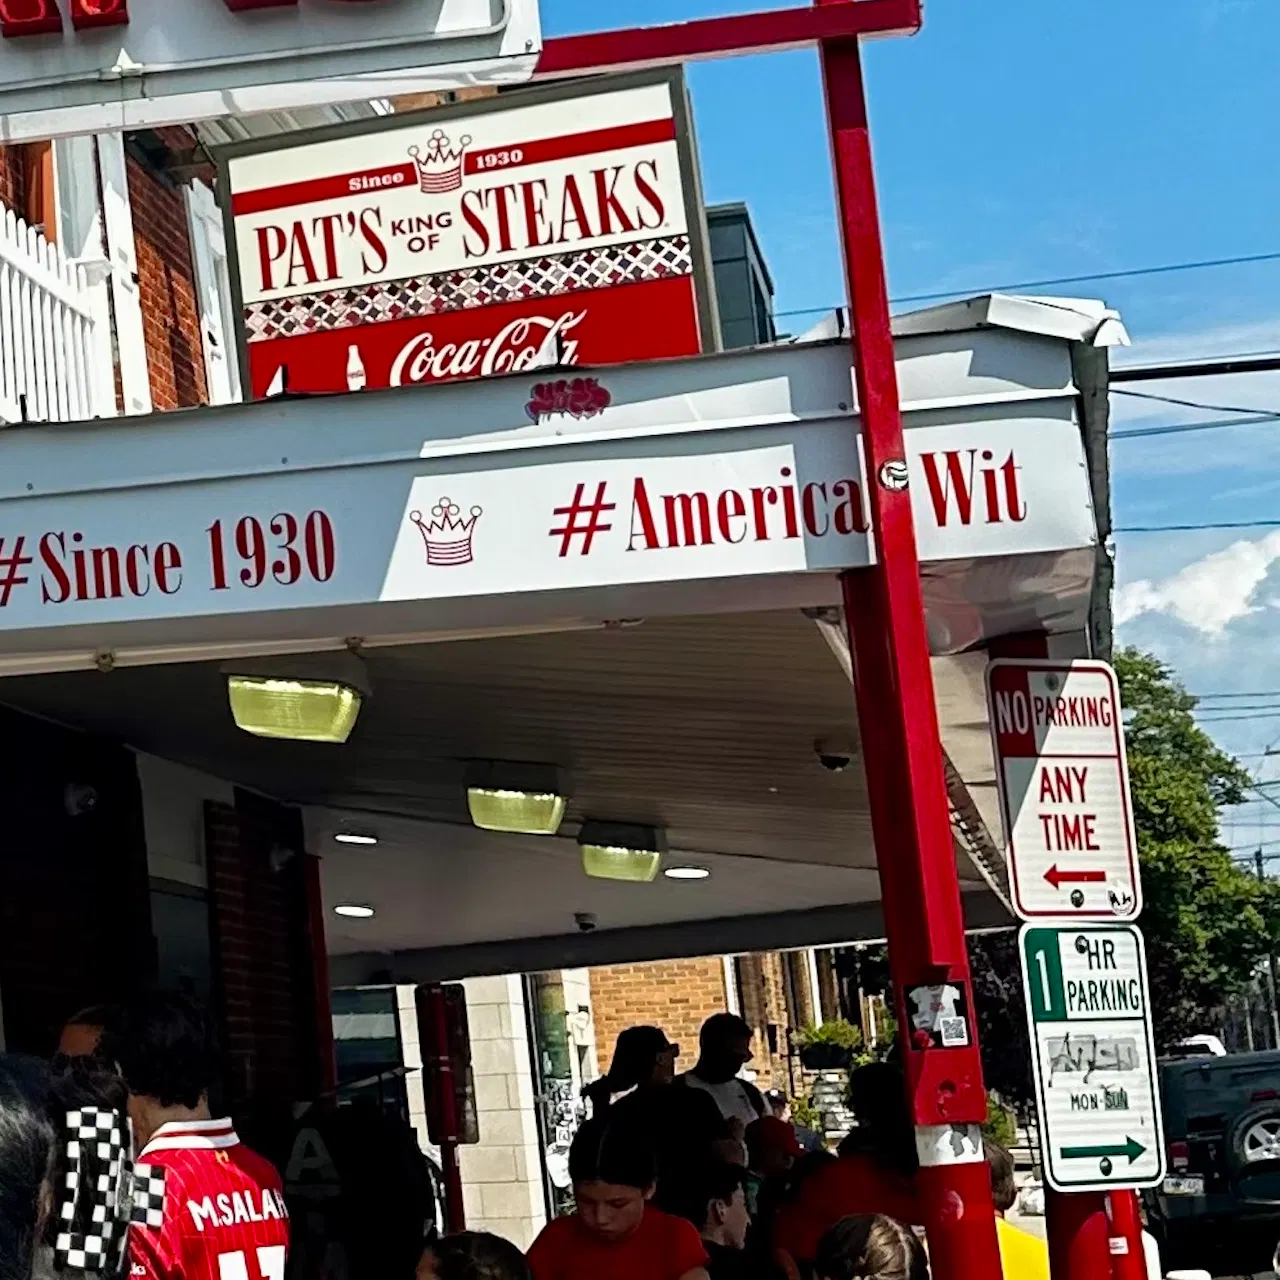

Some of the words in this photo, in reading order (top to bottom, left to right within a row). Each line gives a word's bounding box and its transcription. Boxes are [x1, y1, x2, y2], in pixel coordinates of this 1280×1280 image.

[348, 170, 405, 191] Since
[475, 149, 524, 169] 1930
[253, 207, 388, 292] PAT'S
[460, 160, 666, 259] STEAKS
[391, 212, 452, 237] KING
[408, 235, 440, 254] OF
[548, 466, 874, 558] #America
[920, 448, 1027, 528] Wit
[206, 510, 335, 590] 1930
[995, 690, 1029, 735] NO
[1034, 696, 1111, 728] PARKING
[1039, 767, 1088, 803] ANY
[1038, 814, 1100, 851] TIME
[1087, 939, 1117, 971] HR
[1035, 949, 1052, 1012] 1
[1067, 979, 1139, 1012] PARKING
